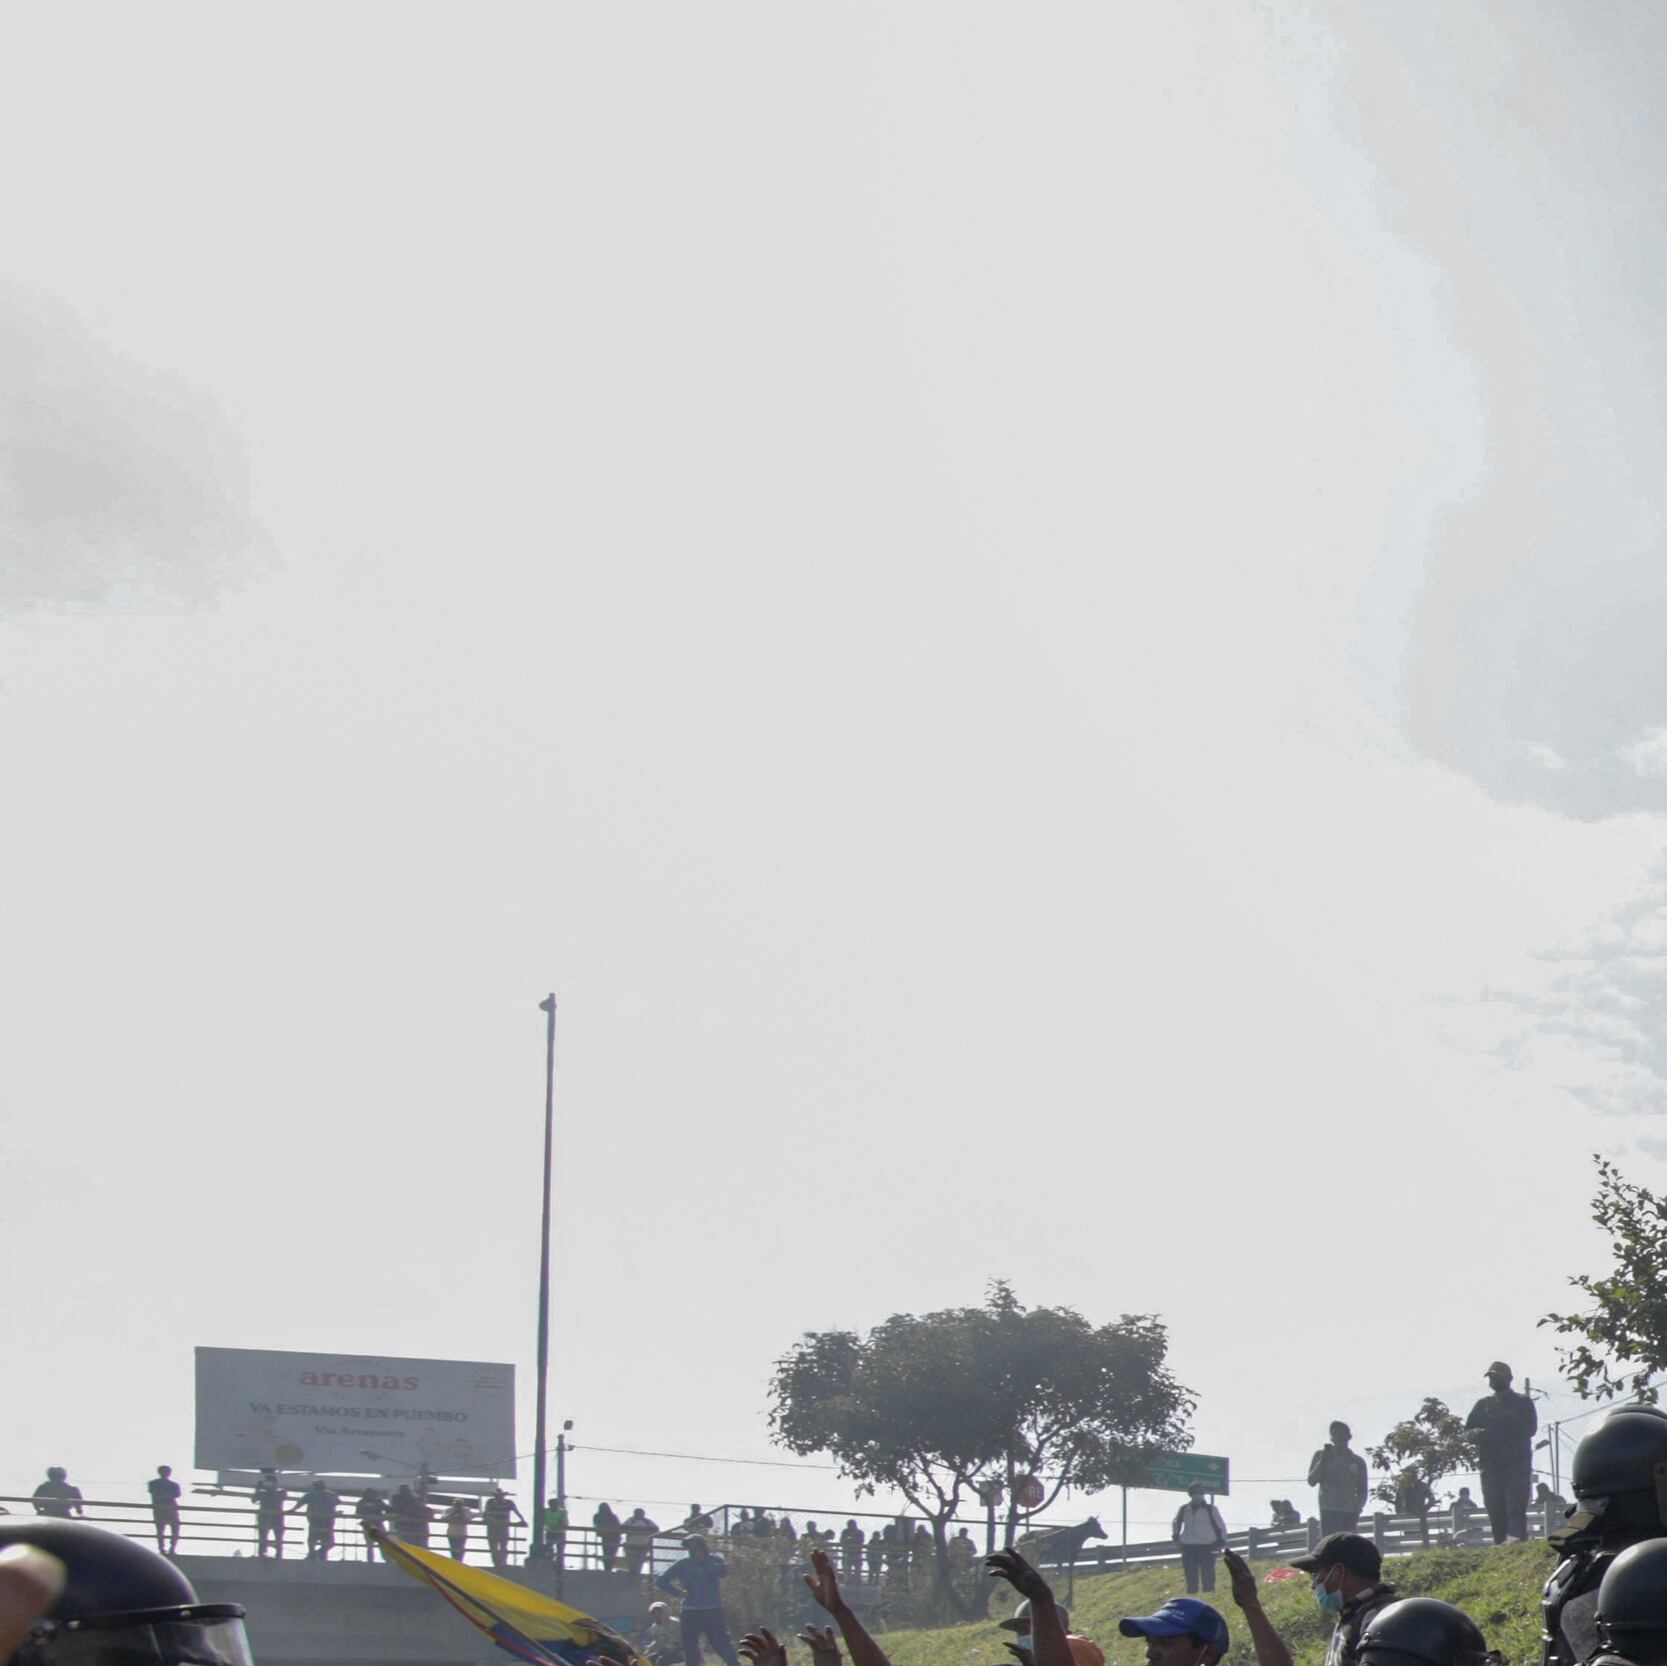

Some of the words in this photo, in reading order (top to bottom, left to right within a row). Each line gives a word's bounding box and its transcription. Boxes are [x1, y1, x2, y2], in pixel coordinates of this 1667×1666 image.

[298, 1371, 419, 1391] arenas
[249, 1402, 272, 1414] YA
[277, 1404, 361, 1419] ESTAMOS
[365, 1407, 389, 1419] EN
[393, 1408, 468, 1422] PUEMBO
